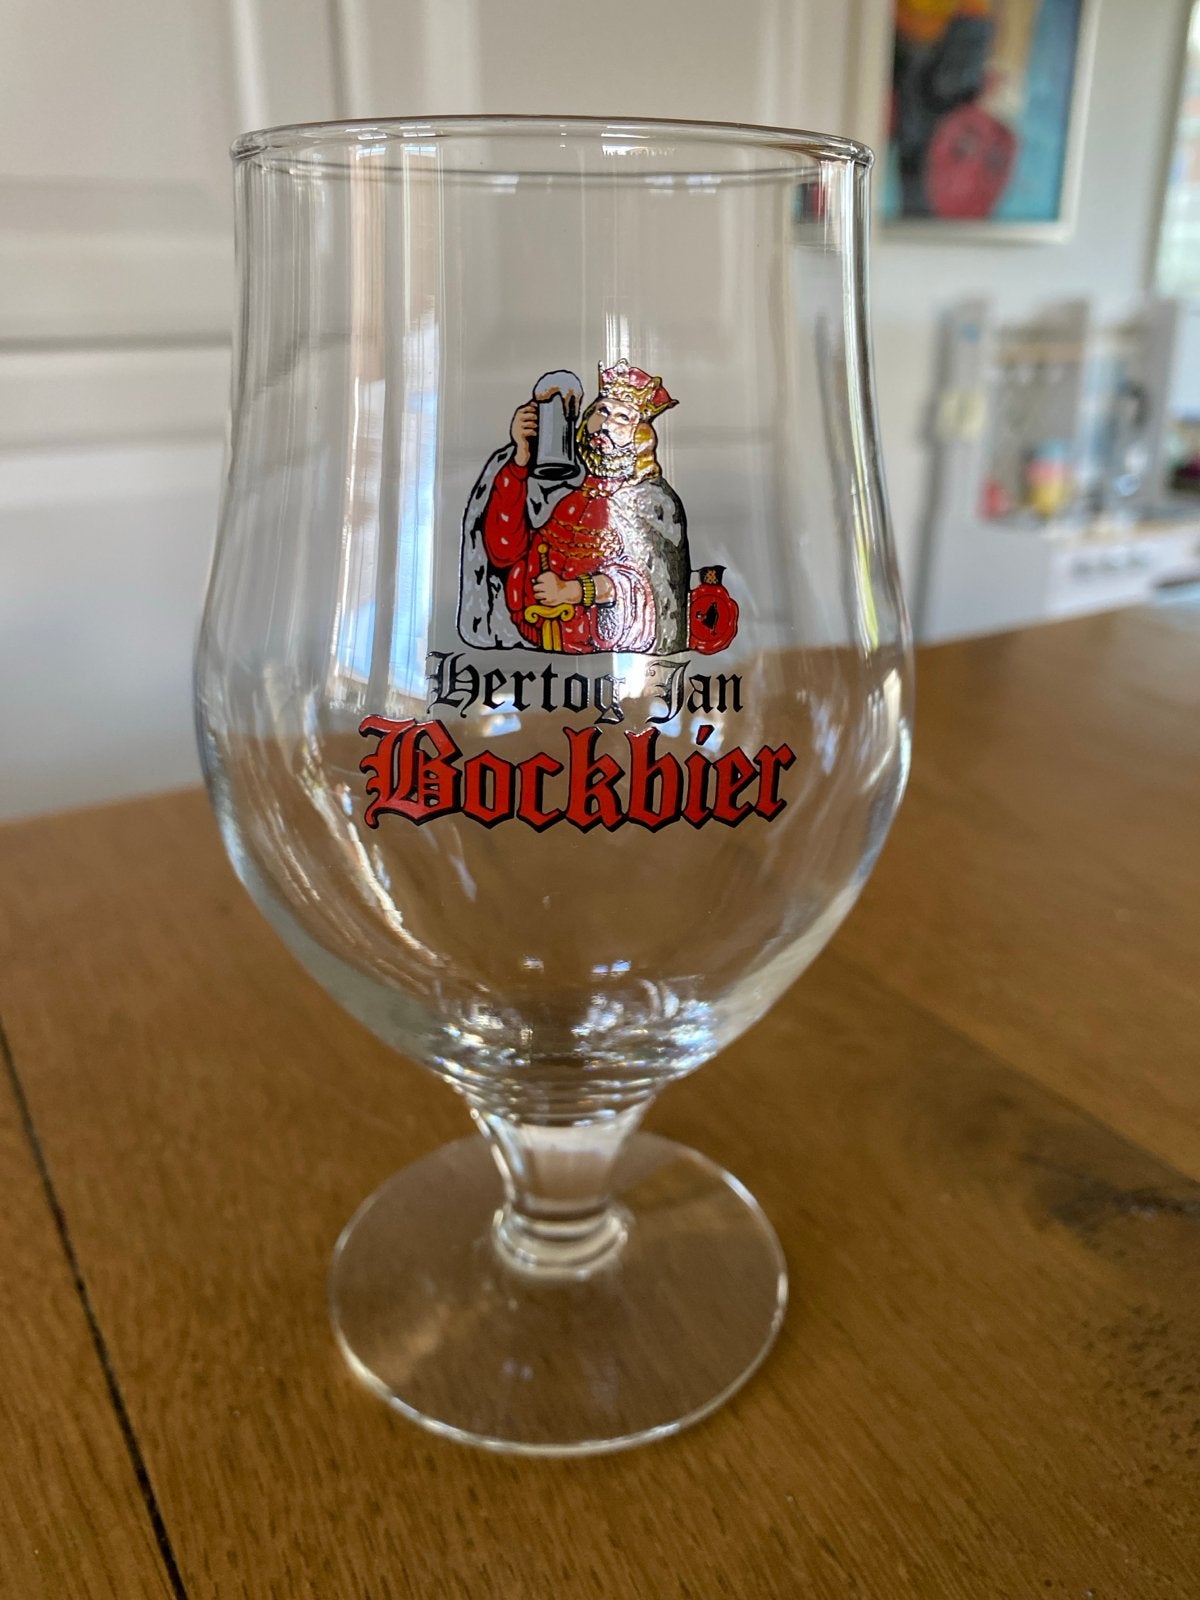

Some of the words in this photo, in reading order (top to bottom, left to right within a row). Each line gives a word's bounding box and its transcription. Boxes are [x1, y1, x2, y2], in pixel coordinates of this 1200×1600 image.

[425, 651, 627, 725] Hertog
[645, 659, 744, 724] Jan
[358, 714, 797, 834] Bockbier
